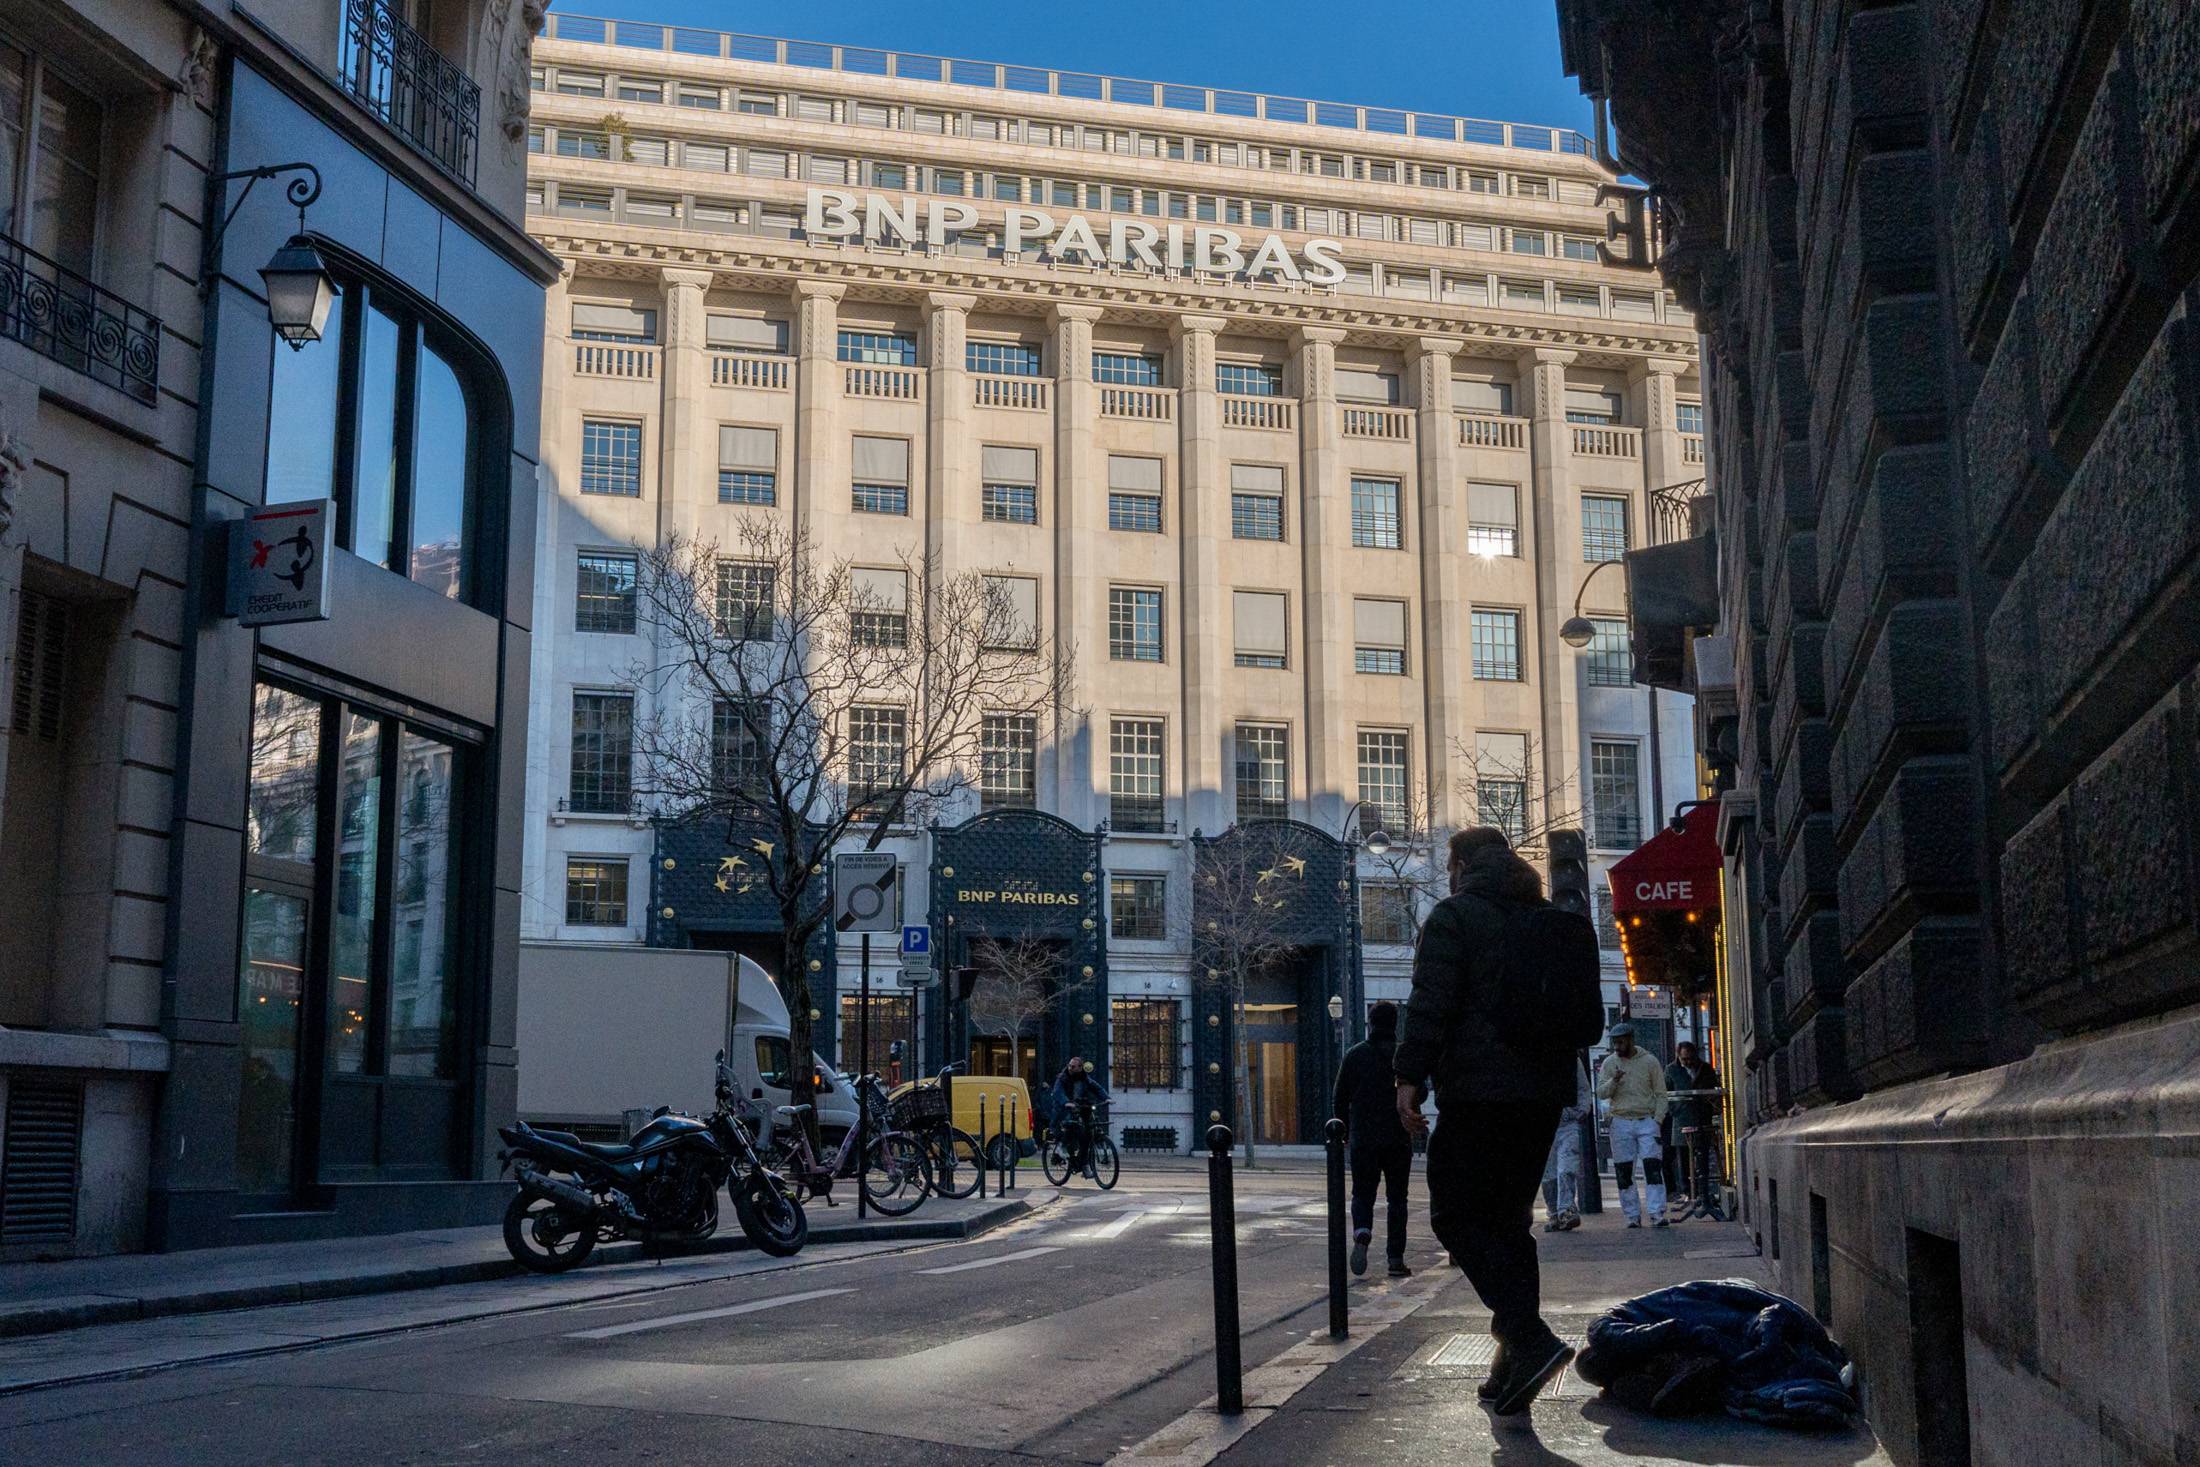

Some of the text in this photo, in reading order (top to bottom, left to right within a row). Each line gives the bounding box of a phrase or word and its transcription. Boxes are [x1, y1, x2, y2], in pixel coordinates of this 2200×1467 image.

[806, 188, 1348, 285] BNP PARIBAS
[248, 593, 283, 604] CREDIT
[248, 600, 313, 614] COOPERATIF
[958, 890, 1079, 905] BNP PARIBAS
[1635, 881, 1693, 900] CAFE
[910, 931, 922, 948] P
